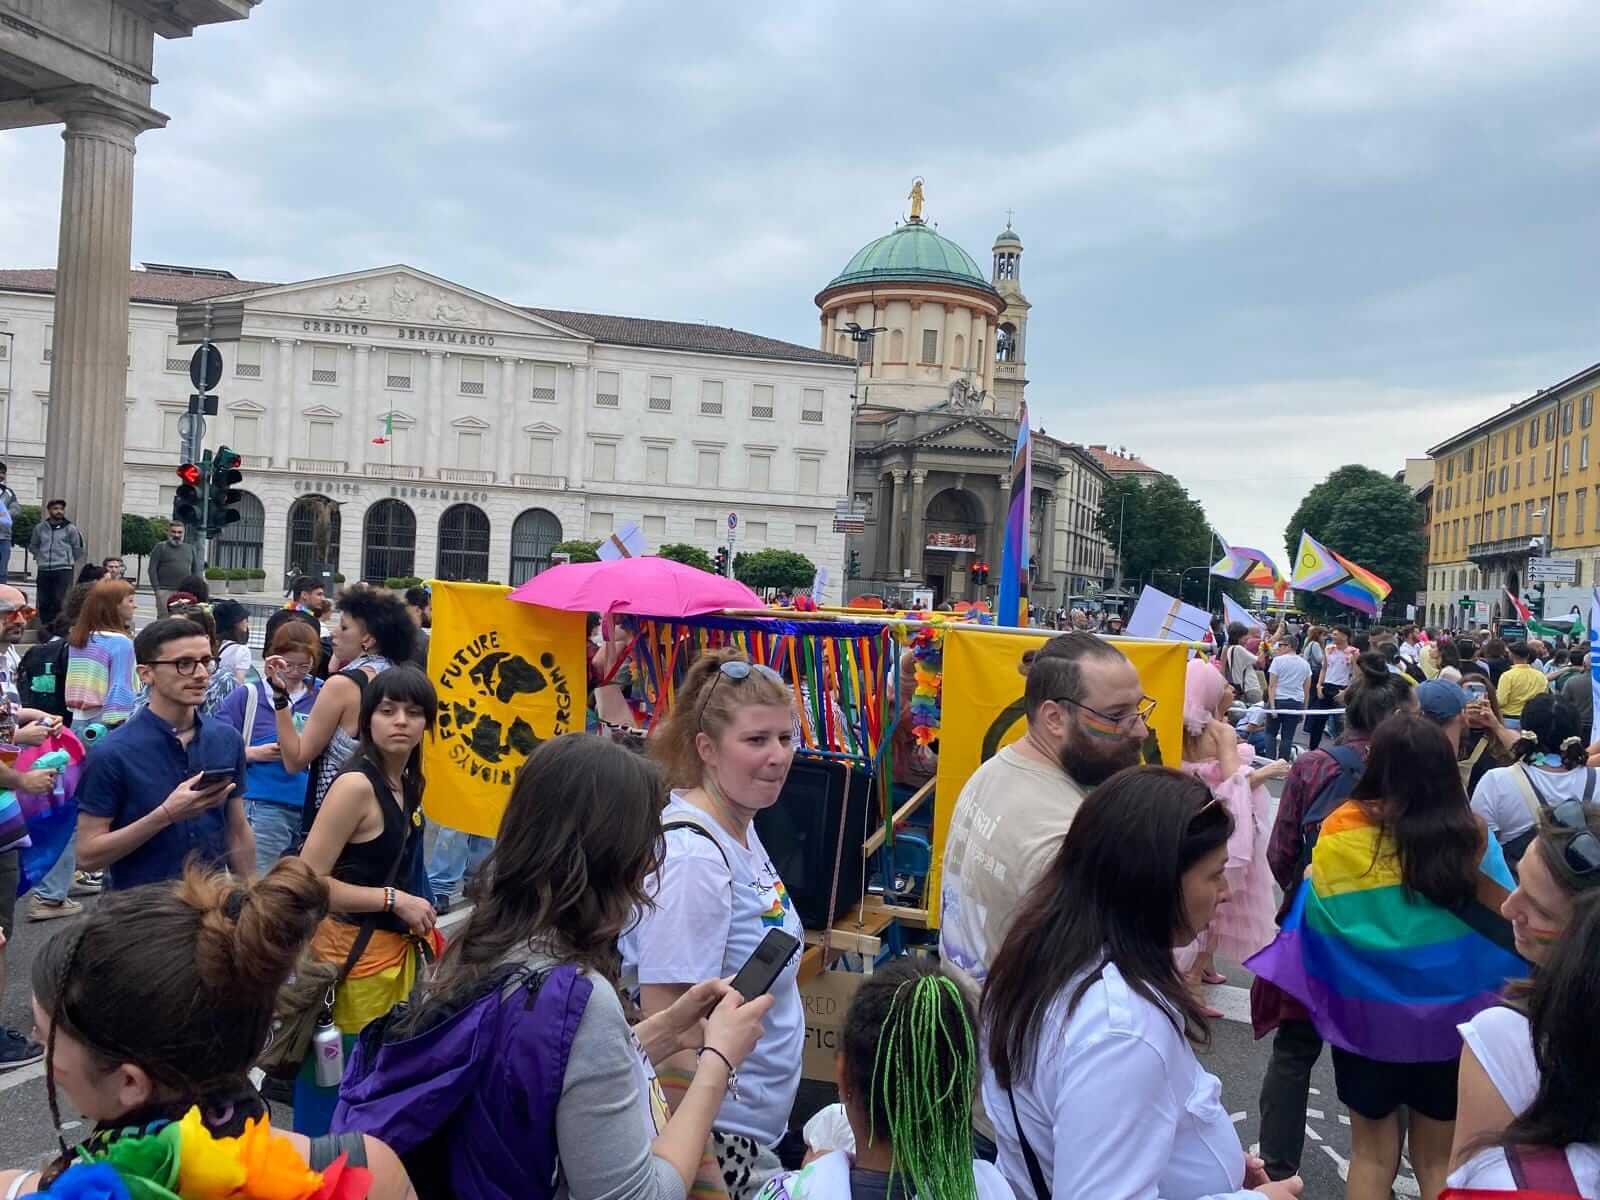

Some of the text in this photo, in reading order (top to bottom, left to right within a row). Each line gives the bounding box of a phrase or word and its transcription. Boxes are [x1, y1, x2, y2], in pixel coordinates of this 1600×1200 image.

[303, 320, 495, 347] CREDITO BERGAMASCO
[294, 480, 488, 502] CREDITO BERGAMASCO
[540, 651, 571, 736] ERGAMO
[438, 631, 513, 786] RIDAYS FOR FUTURE
[800, 994, 837, 1015] RED
